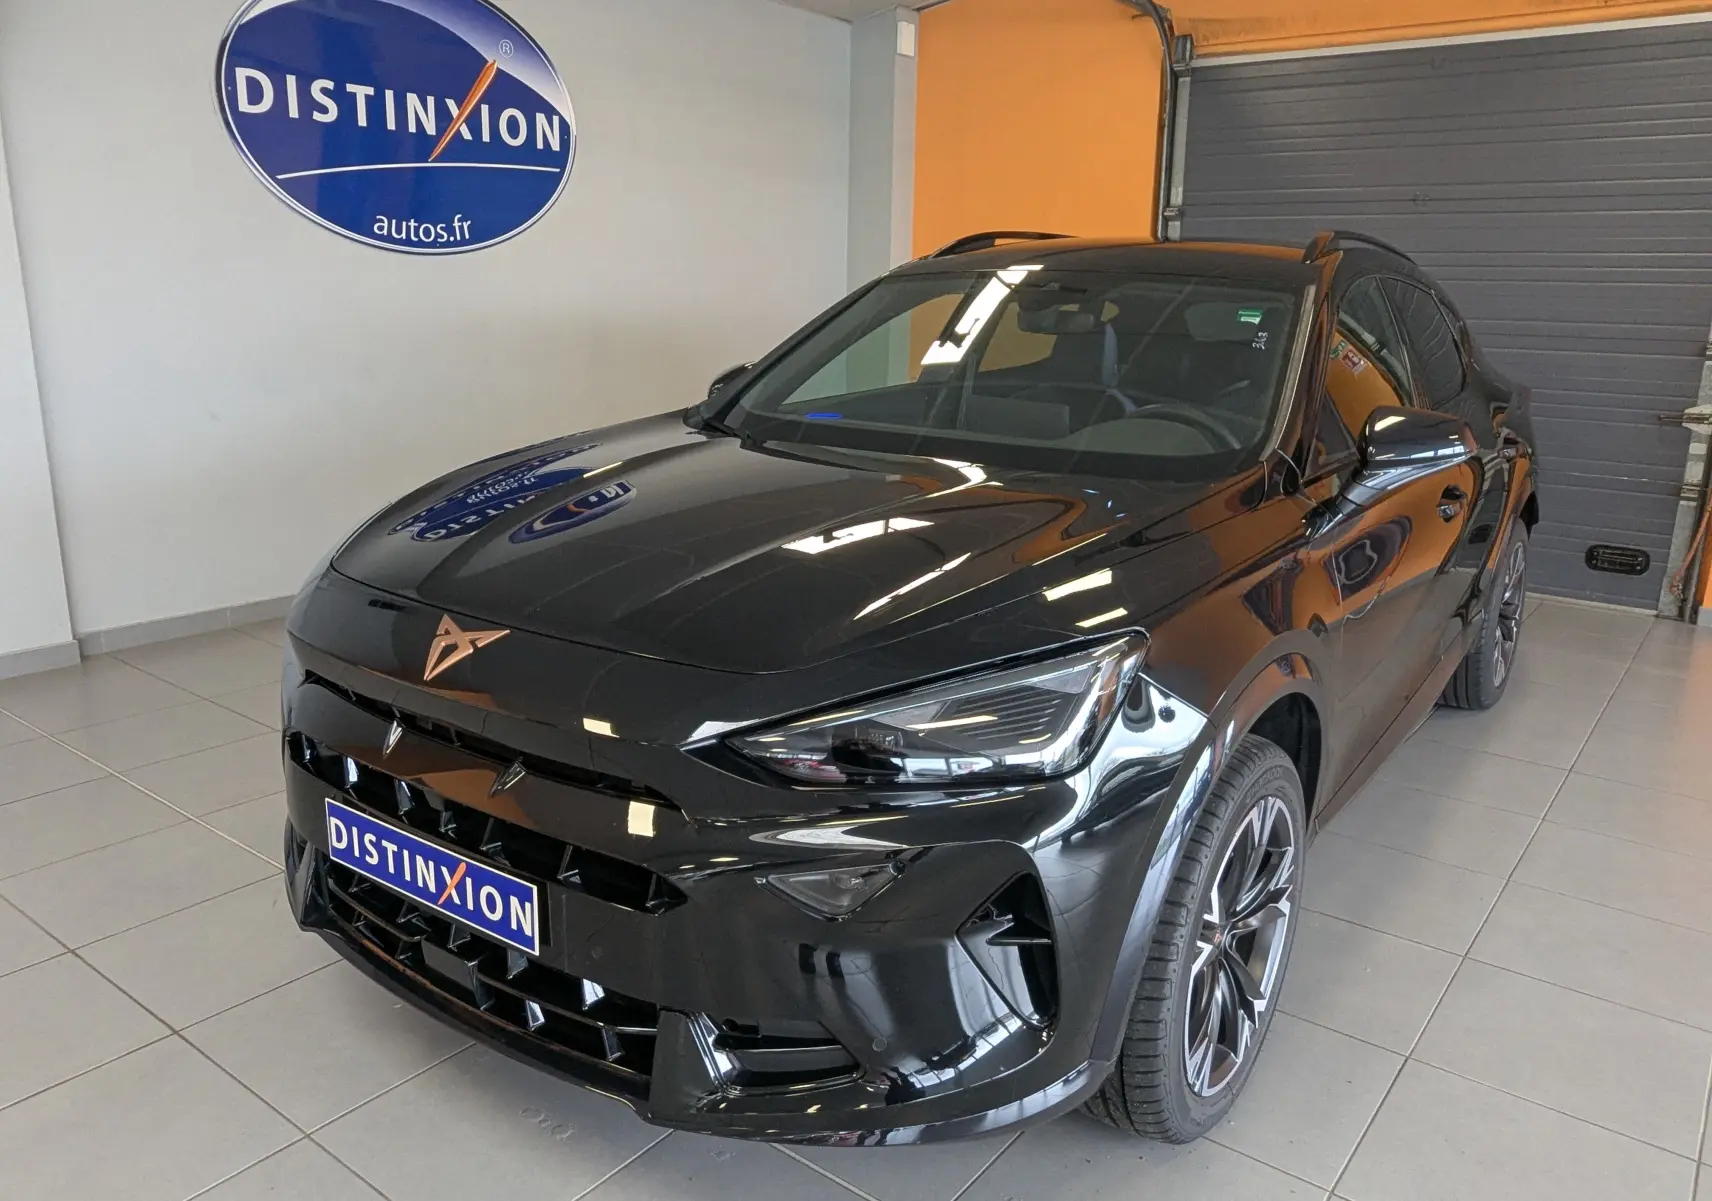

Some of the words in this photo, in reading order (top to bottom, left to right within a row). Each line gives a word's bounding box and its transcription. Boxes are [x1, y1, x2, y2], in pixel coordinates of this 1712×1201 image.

[235, 59, 561, 162] DISTINXION
[373, 214, 472, 243] autos.fr
[329, 816, 533, 937] DISTINXION
